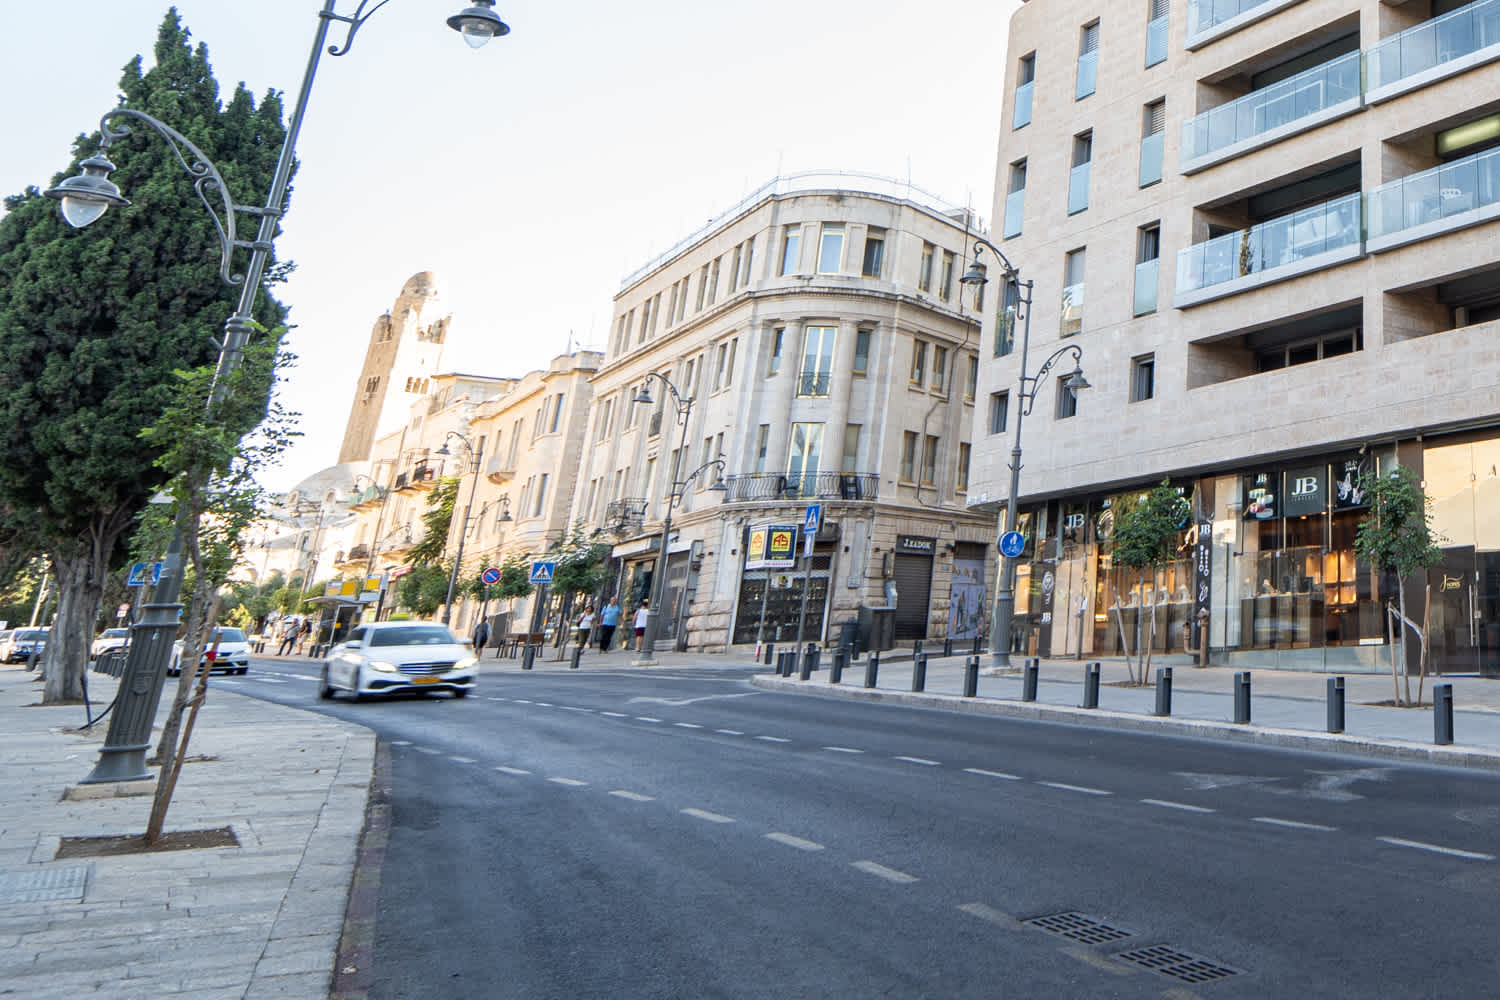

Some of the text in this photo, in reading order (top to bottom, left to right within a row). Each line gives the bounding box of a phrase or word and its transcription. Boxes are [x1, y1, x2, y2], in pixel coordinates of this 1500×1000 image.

[1291, 476, 1319, 496] JB
[1064, 514, 1085, 529] JB
[1200, 524, 1211, 536] JB
[1041, 612, 1052, 624] JB
